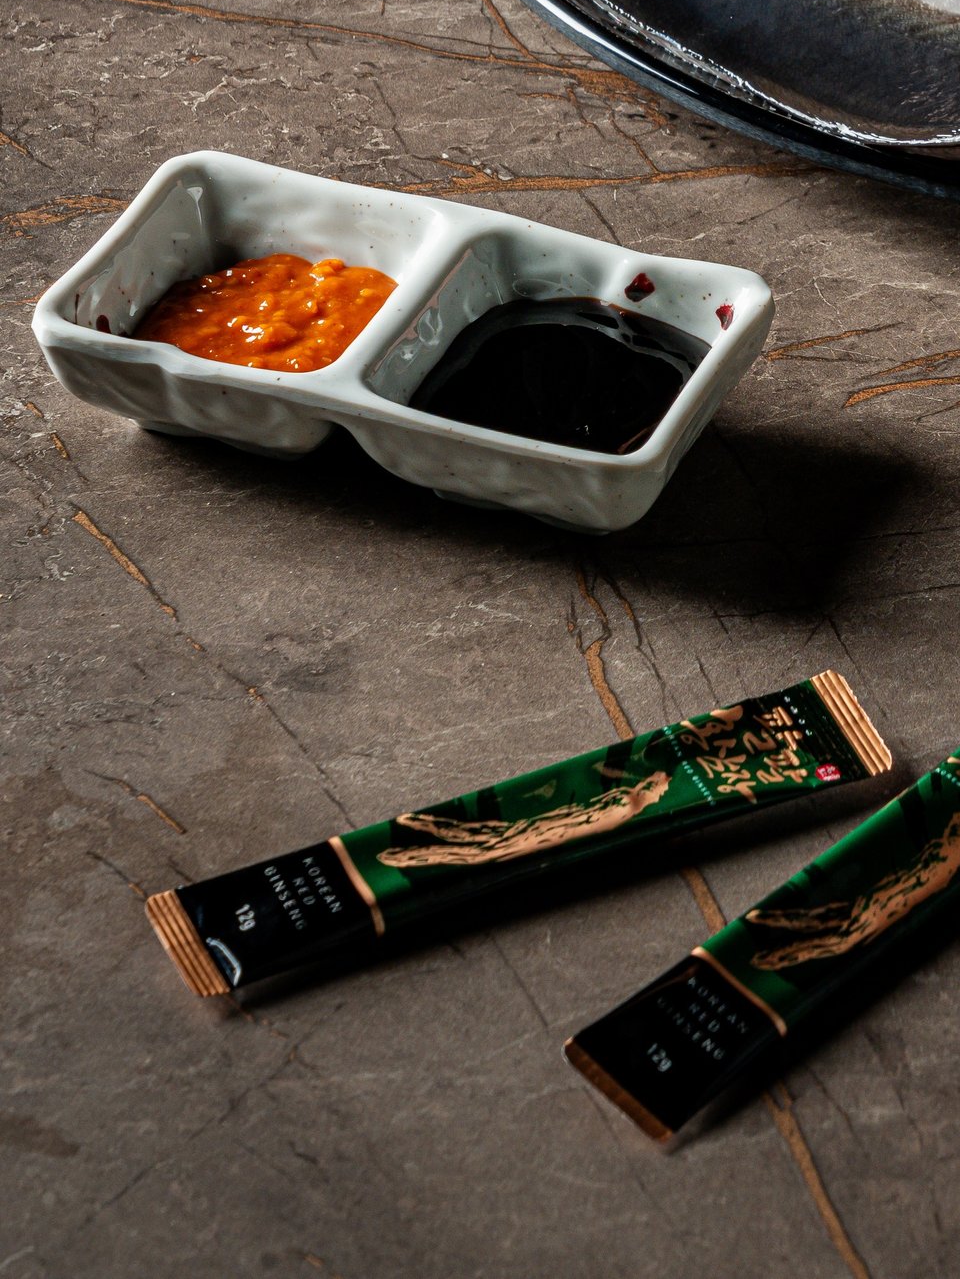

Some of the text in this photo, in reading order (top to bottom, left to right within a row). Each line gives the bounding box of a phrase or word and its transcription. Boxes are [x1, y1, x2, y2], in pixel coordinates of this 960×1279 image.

[264, 865, 308, 931] GINSENG
[292, 876, 317, 906] RED
[302, 856, 344, 913] KOREAN
[234, 903, 256, 932] 12g
[687, 976, 751, 1034] KOREAN
[688, 1002, 721, 1033] RED
[657, 996, 726, 1061] GINSENG
[646, 1042, 673, 1073] 12g
